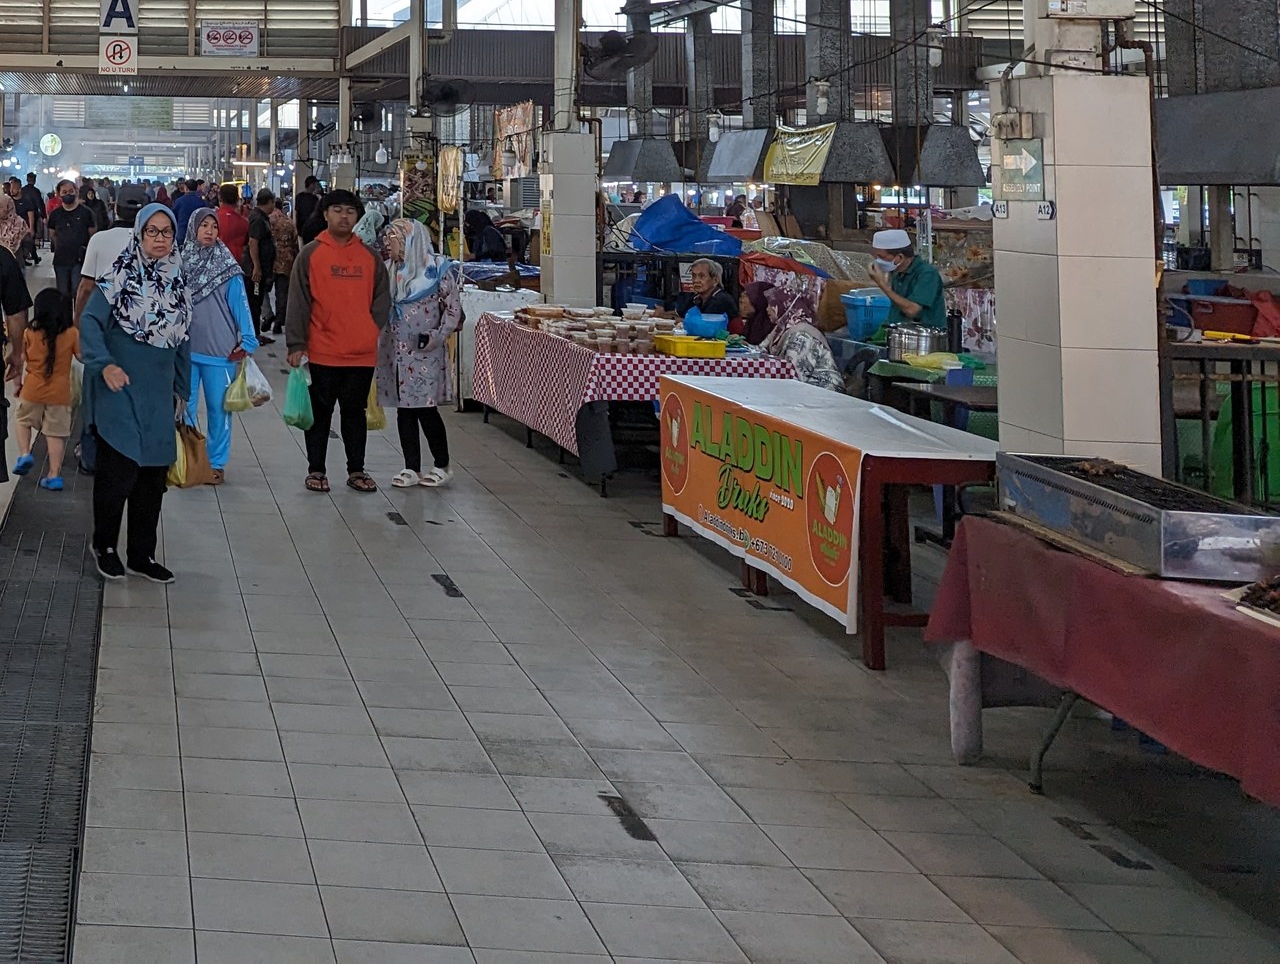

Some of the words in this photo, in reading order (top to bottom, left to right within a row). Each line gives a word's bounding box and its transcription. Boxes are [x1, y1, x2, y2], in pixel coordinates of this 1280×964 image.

[1002, 183, 1024, 193] ASSEMBLY
[1026, 183, 1041, 193] POINT
[995, 204, 1006, 214] A13
[1037, 204, 1050, 215] A12
[690, 399, 804, 498] ALADDIN
[812, 519, 848, 549] ALADDIN
